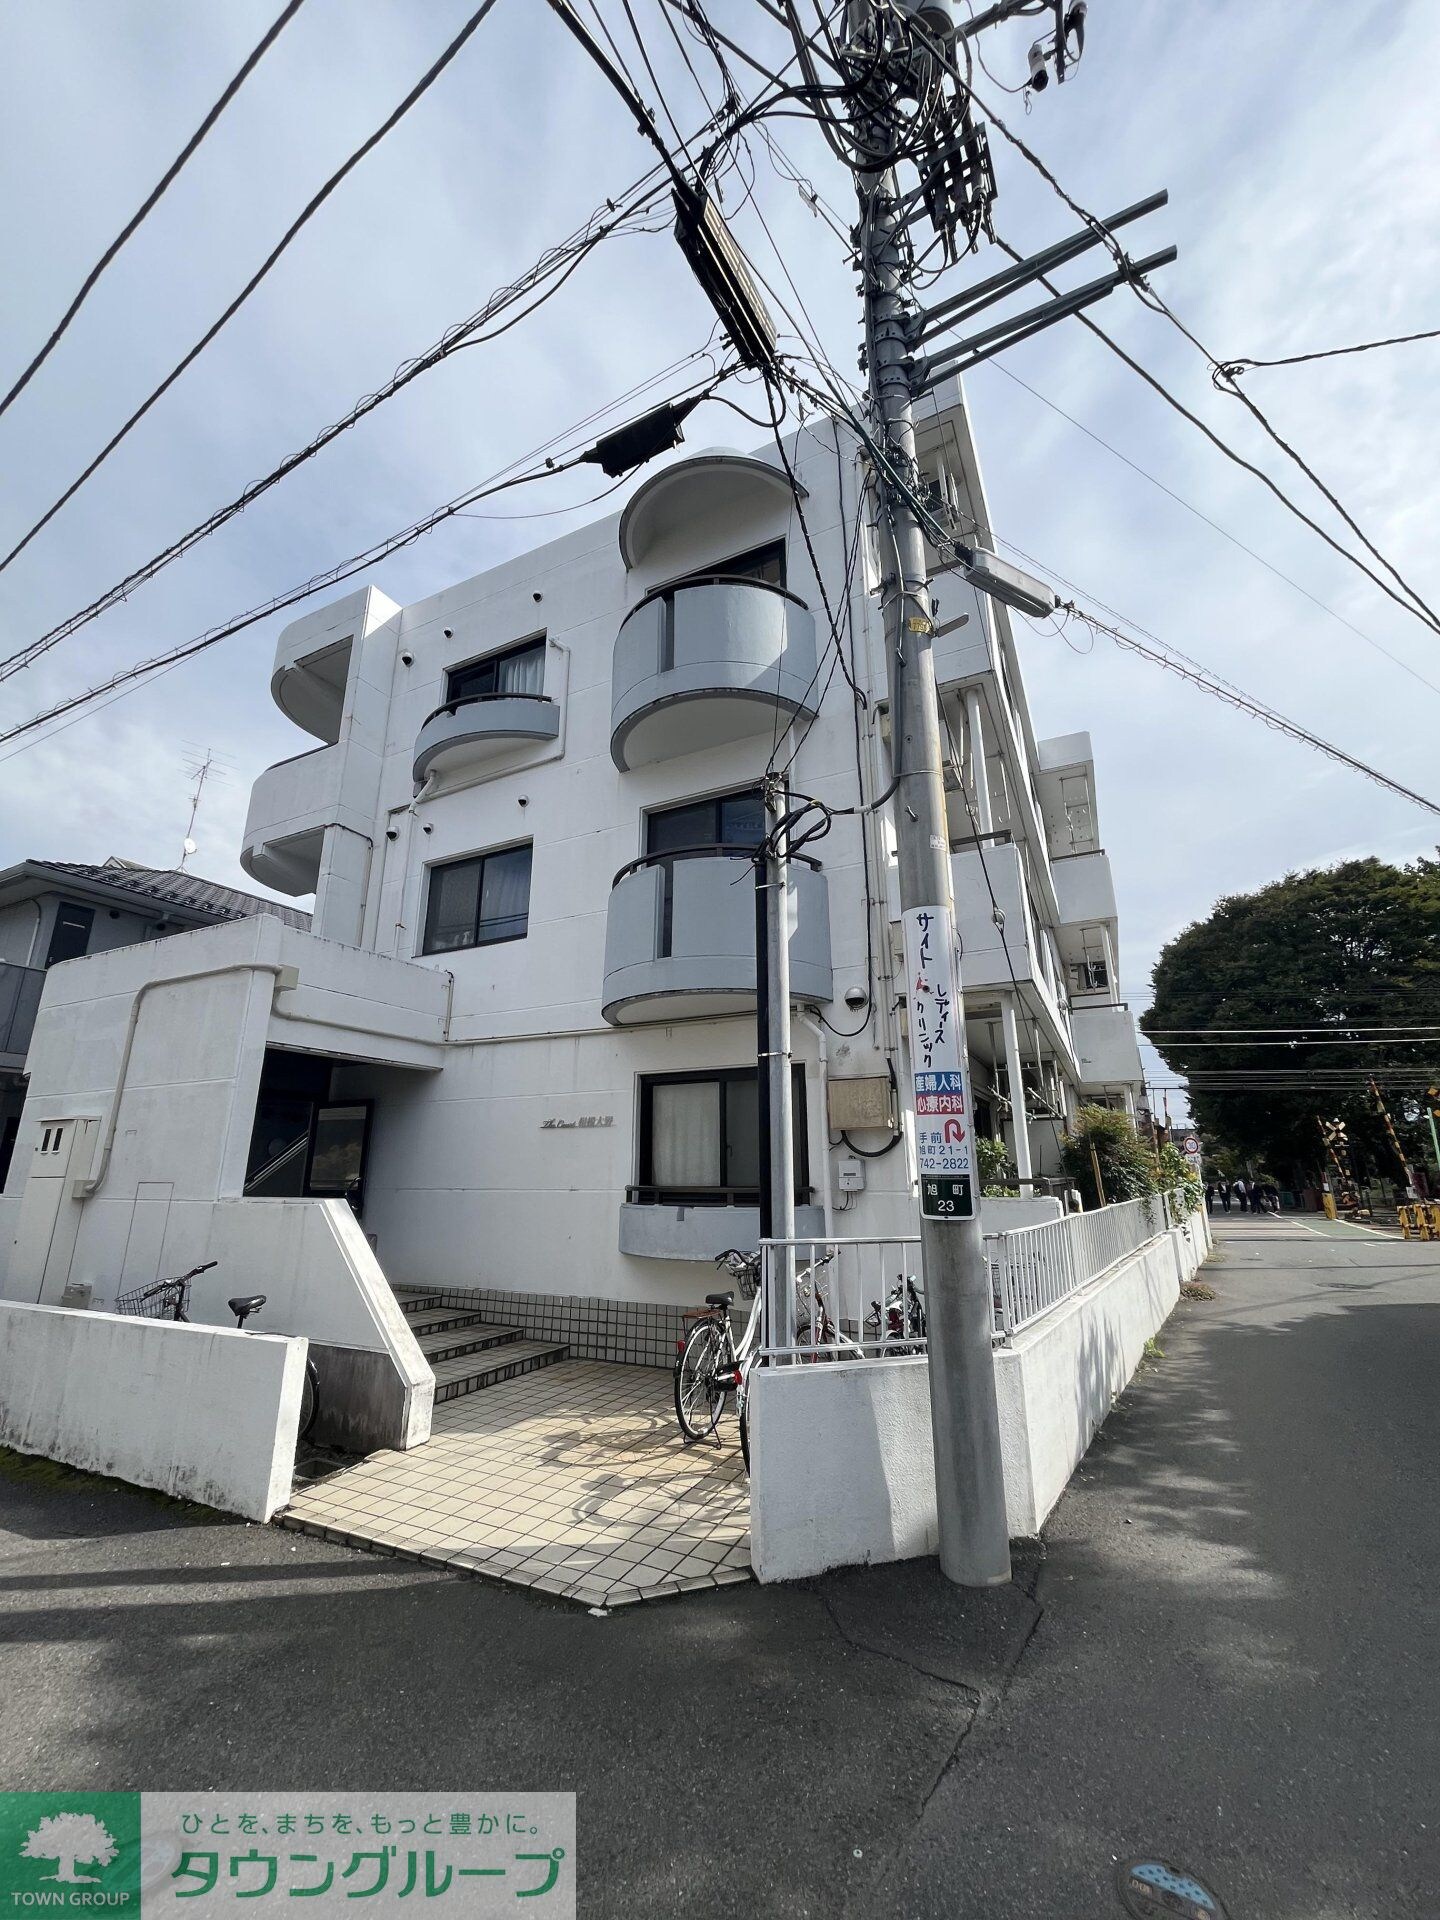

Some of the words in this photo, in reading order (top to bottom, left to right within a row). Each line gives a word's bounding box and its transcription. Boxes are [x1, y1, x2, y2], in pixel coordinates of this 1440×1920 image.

[916, 912, 934, 969] サイト
[934, 983, 950, 1044] レディース
[916, 1001, 933, 1068] クリニック
[915, 1073, 961, 1092] 産婦人科
[917, 1096, 964, 1113] 心療内科
[919, 1131, 942, 1144] 手前
[919, 1157, 969, 1170] 742-2822
[927, 1183, 964, 1196] 旭町
[937, 1200, 955, 1212] 23
